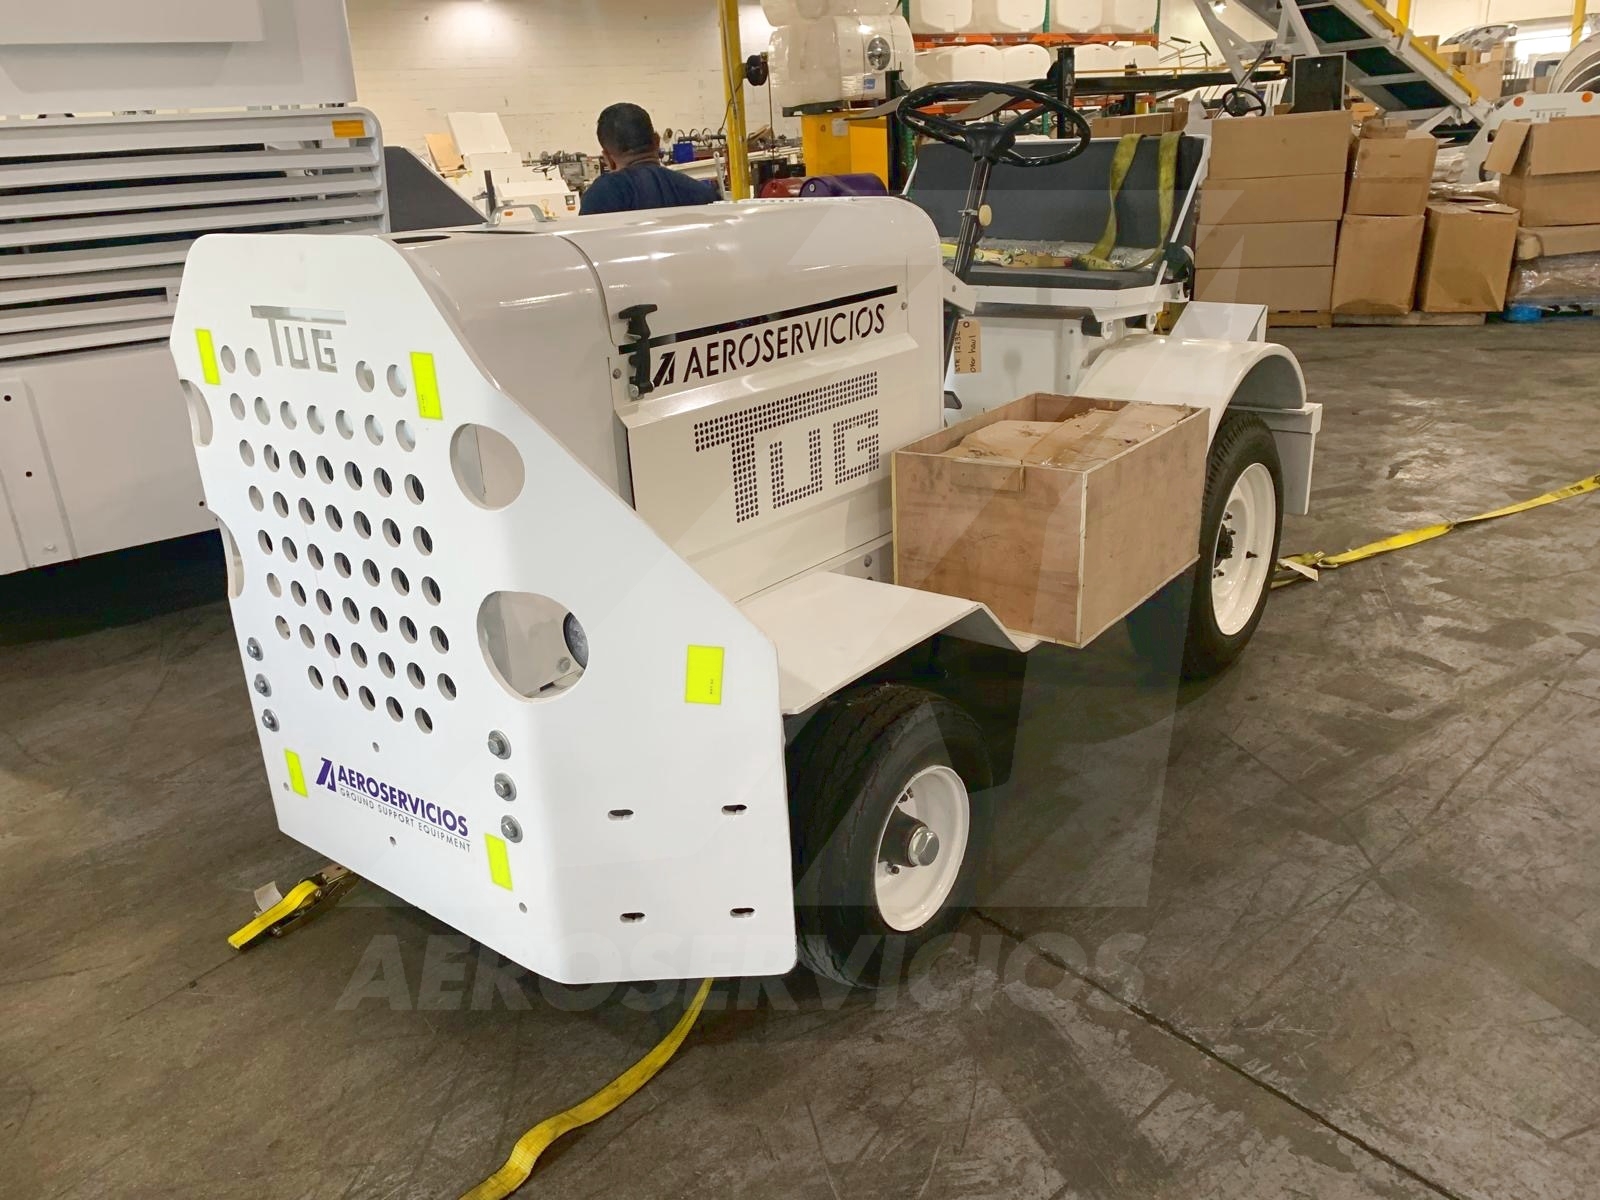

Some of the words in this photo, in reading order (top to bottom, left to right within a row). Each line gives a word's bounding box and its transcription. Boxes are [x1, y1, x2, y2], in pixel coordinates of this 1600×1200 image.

[251, 305, 348, 373] TUG
[683, 303, 886, 383] AEROSERVICIOS
[694, 371, 881, 523] TUG
[338, 765, 469, 837] AEROSERVICIOS
[339, 787, 375, 810] GROUND
[377, 805, 415, 828] SUPPORT
[417, 822, 471, 853] EQUIPMENT
